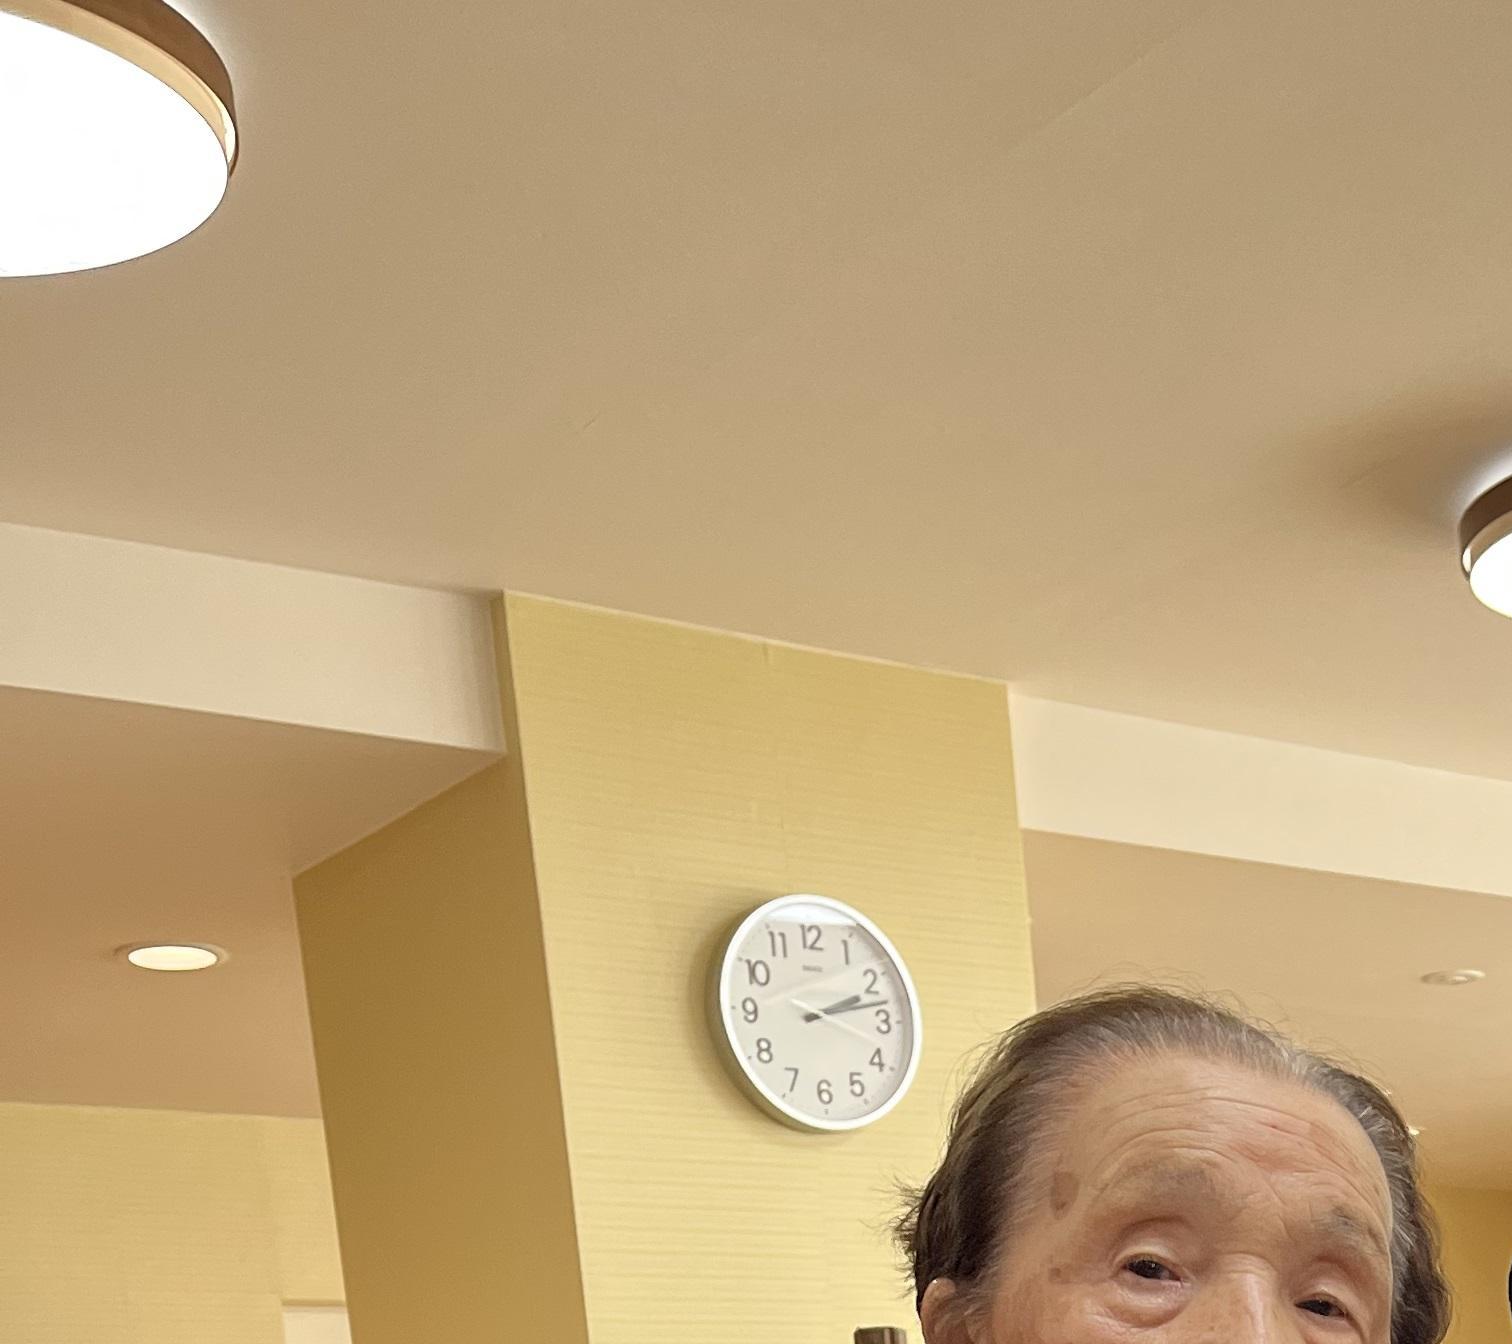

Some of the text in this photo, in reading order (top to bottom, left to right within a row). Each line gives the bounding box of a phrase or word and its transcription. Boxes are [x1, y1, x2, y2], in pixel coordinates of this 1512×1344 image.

[767, 930, 788, 958] 11
[799, 923, 824, 951] 12
[841, 938, 851, 966] 1
[745, 958, 771, 987] 10
[862, 968, 880, 995] 2
[741, 996, 759, 1024] 9
[874, 1009, 892, 1035] 3
[755, 1037, 774, 1064] 8
[868, 1047, 886, 1073] 4
[783, 1067, 799, 1093] 7
[816, 1079, 834, 1105] 6
[848, 1071, 866, 1097] 5
